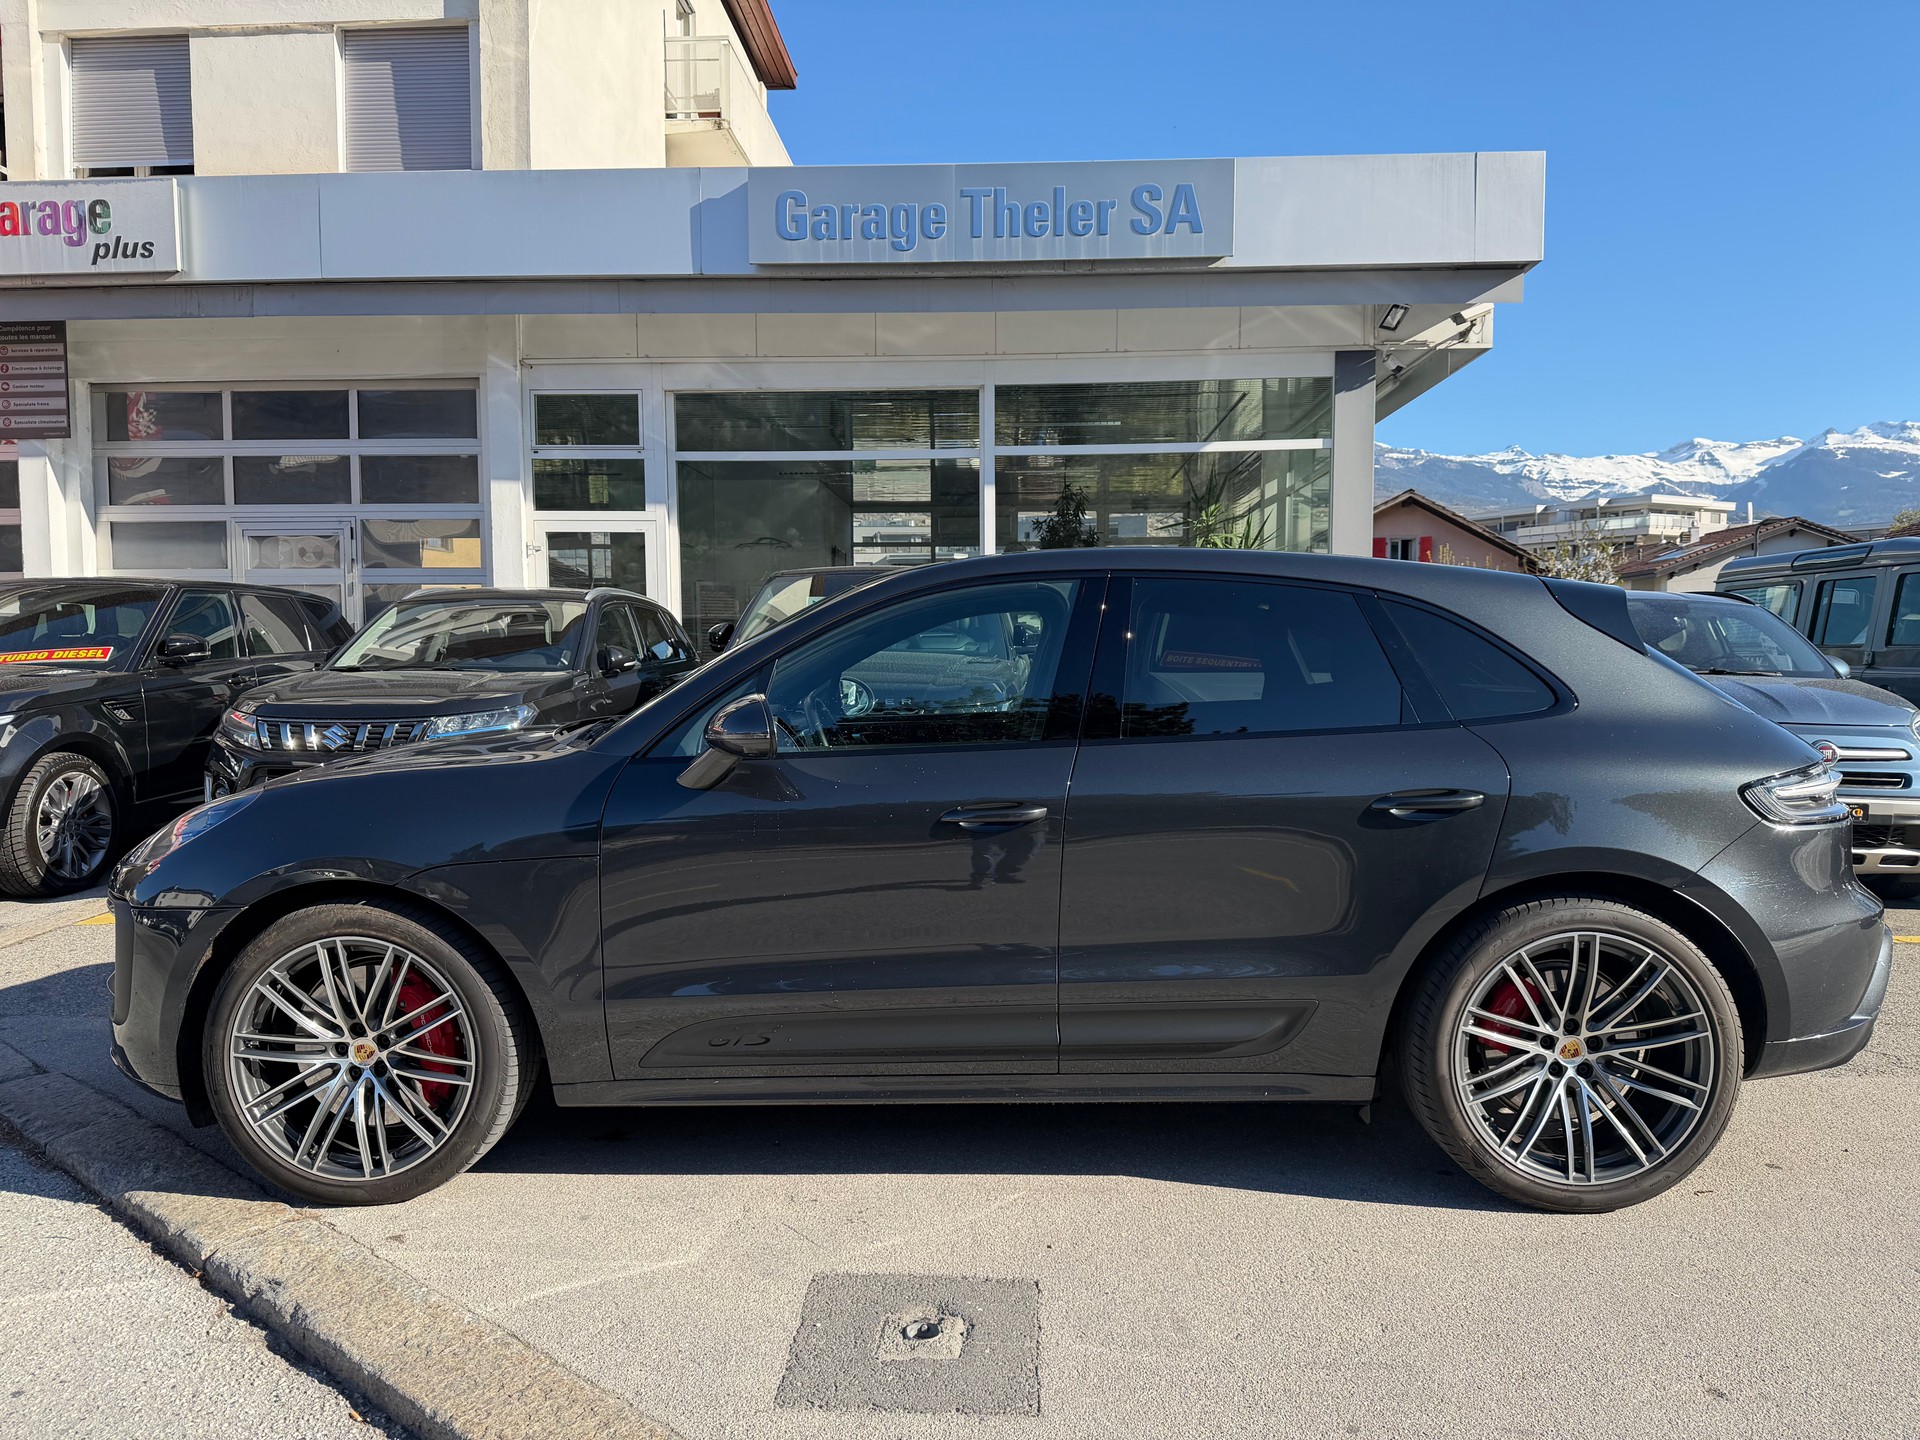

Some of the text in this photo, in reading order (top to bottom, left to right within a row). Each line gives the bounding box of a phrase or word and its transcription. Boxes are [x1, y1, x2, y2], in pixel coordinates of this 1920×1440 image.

[775, 182, 1204, 252] Garage Theler SA
[91, 236, 155, 265] plus
[30, 333, 57, 341] marques
[0, 649, 105, 662] TURBO DIESEL
[1166, 654, 1194, 664] BOITE
